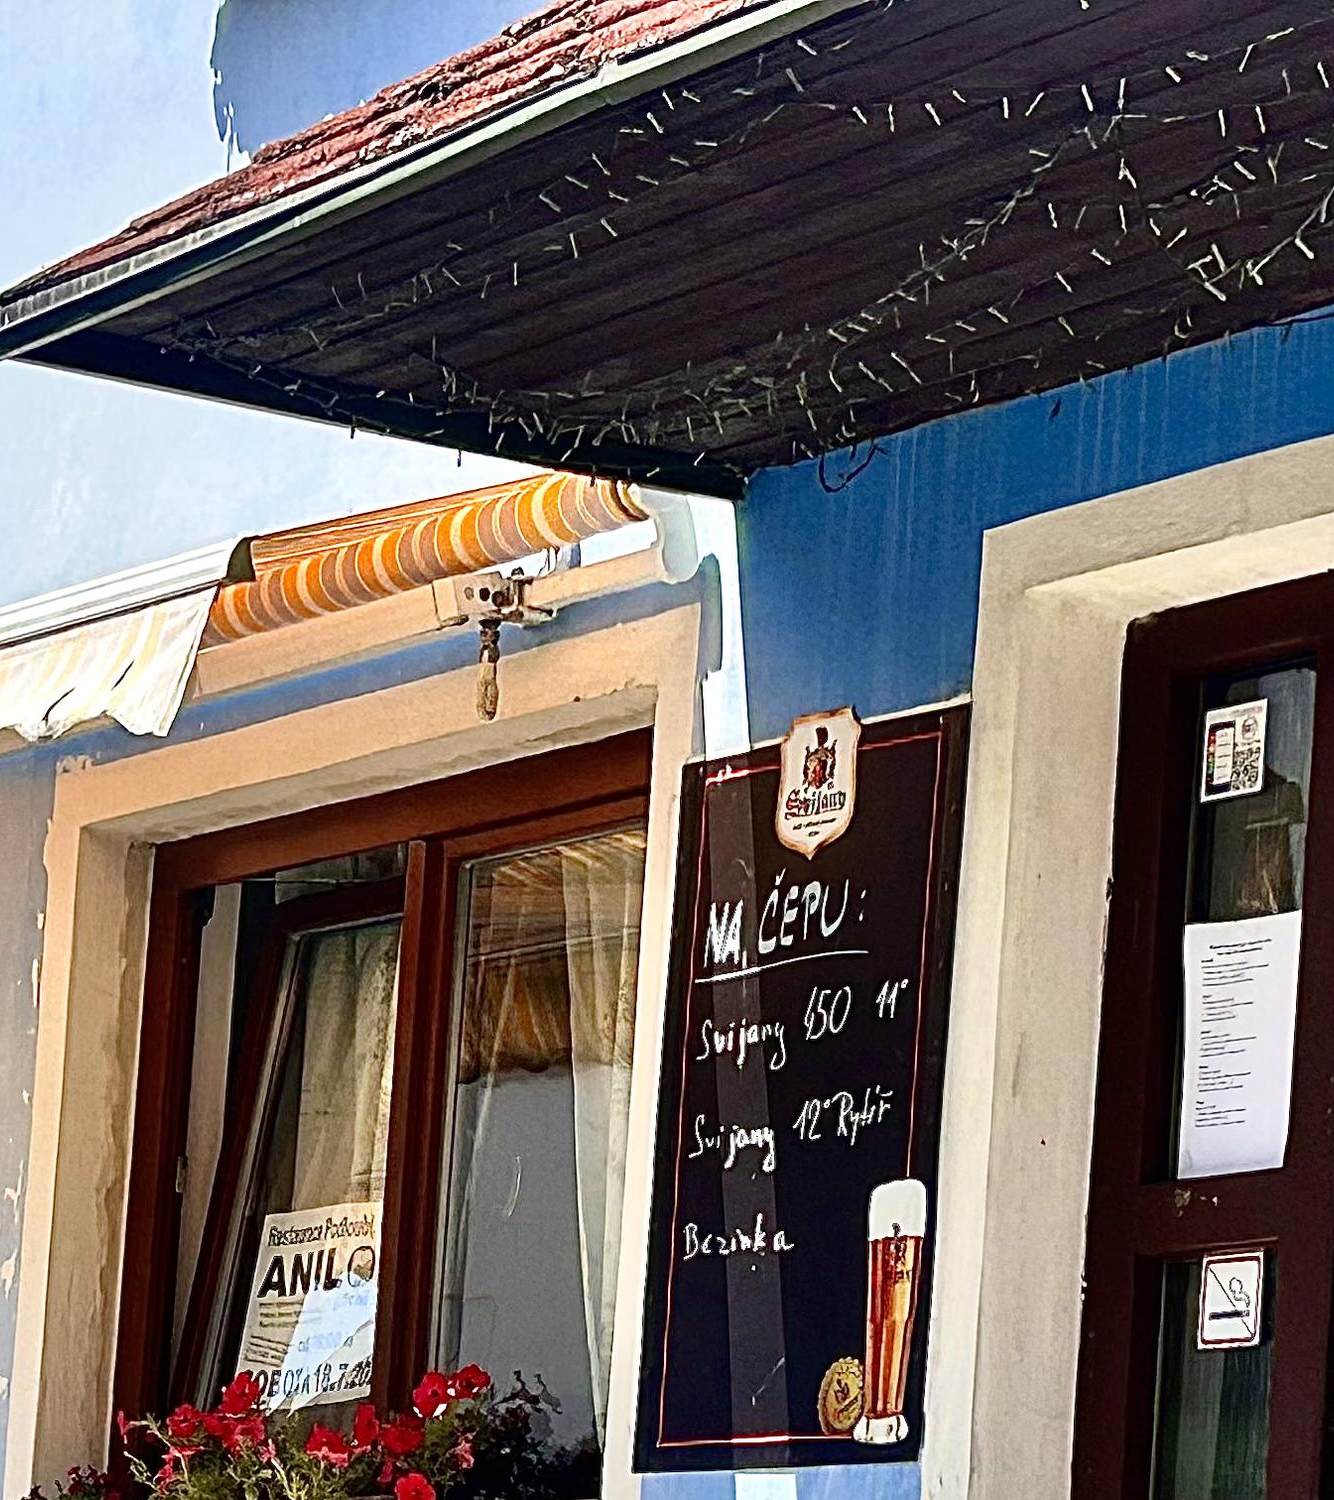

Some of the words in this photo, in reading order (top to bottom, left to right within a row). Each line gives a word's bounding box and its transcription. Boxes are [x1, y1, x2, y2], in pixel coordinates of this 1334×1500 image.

[703, 900, 744, 968] NA
[696, 1018, 786, 1071] Svijany
[688, 1114, 775, 1172] Svijany
[682, 1212, 795, 1261] Bezinka
